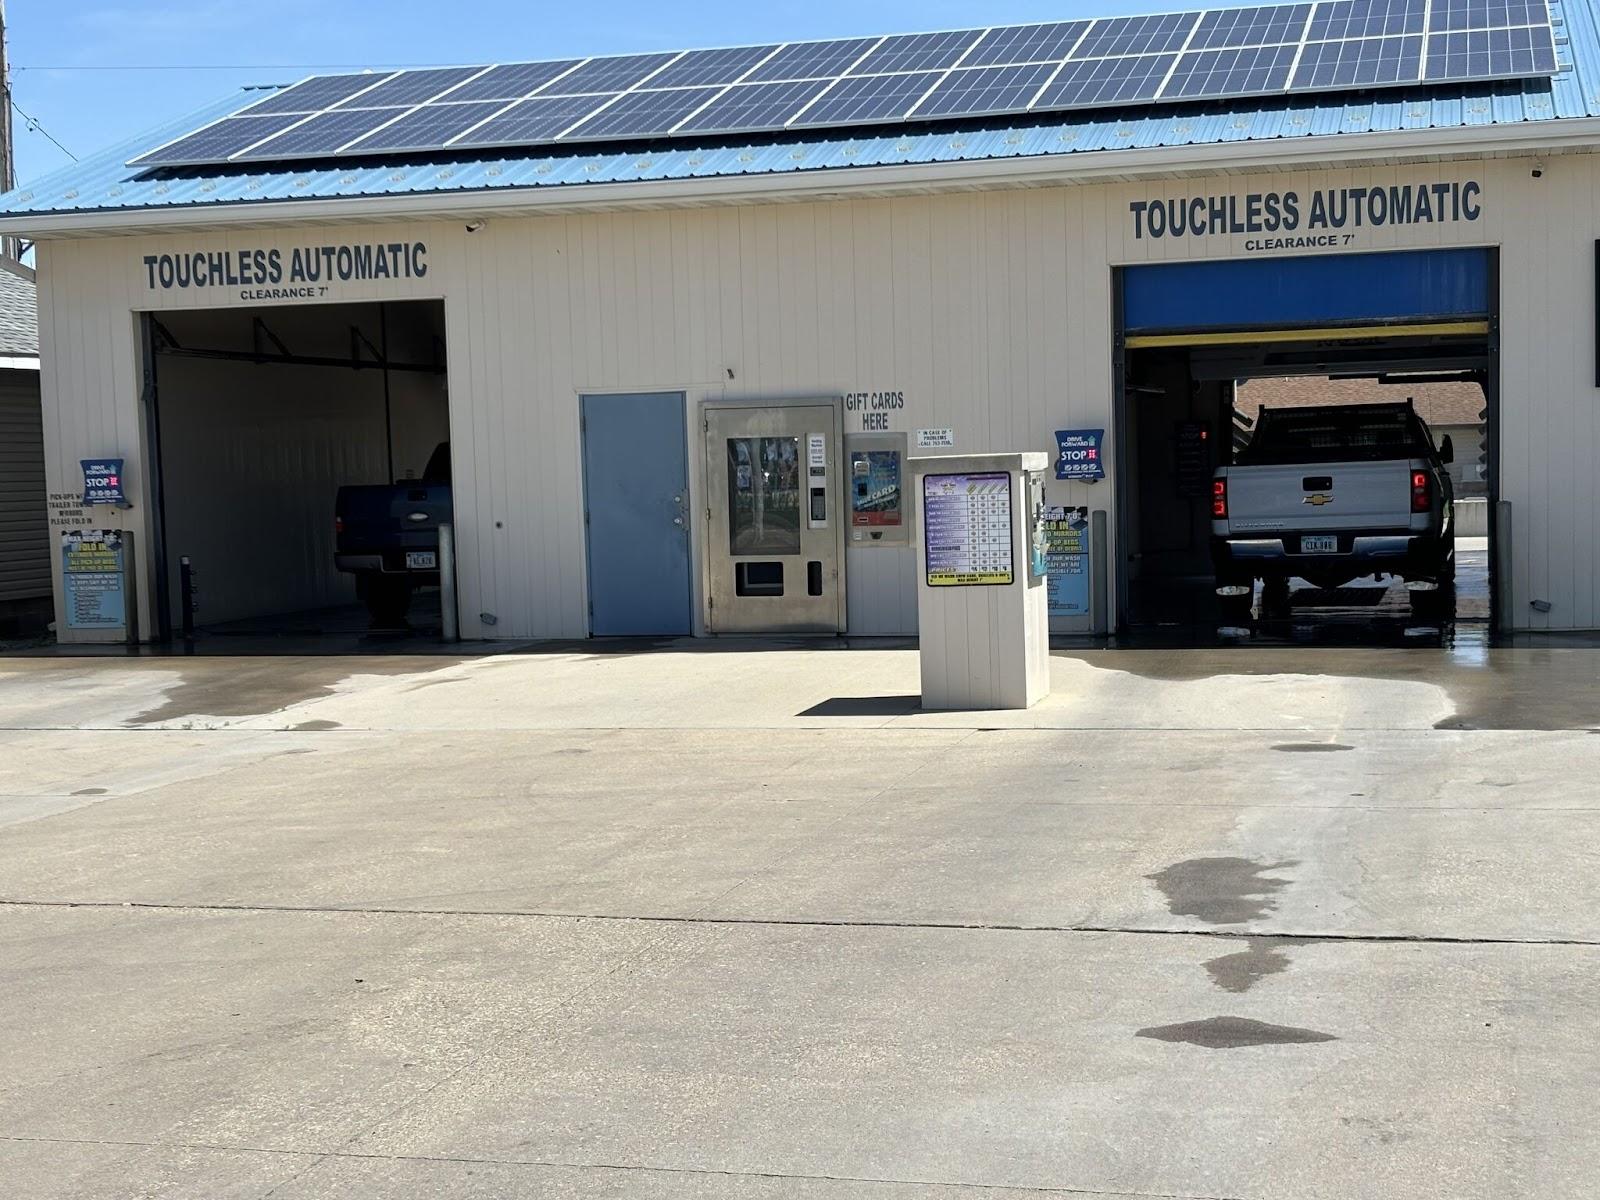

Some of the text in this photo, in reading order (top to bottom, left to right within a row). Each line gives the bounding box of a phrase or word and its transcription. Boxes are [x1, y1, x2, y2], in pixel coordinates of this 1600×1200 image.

[1130, 181, 1481, 239] TOUCHLESS AUTOMATIC
[1245, 234, 1355, 251] CLEARANCE 7'
[144, 242, 428, 289] TOUCHLESS AUTOMATIC
[240, 286, 329, 300] CLEARANCE 7'
[846, 391, 904, 411] GIFT CARDS
[863, 413, 889, 431] HERE
[1061, 450, 1087, 461] STOP
[86, 478, 109, 487] STOP
[1059, 521, 1069, 529] IN
